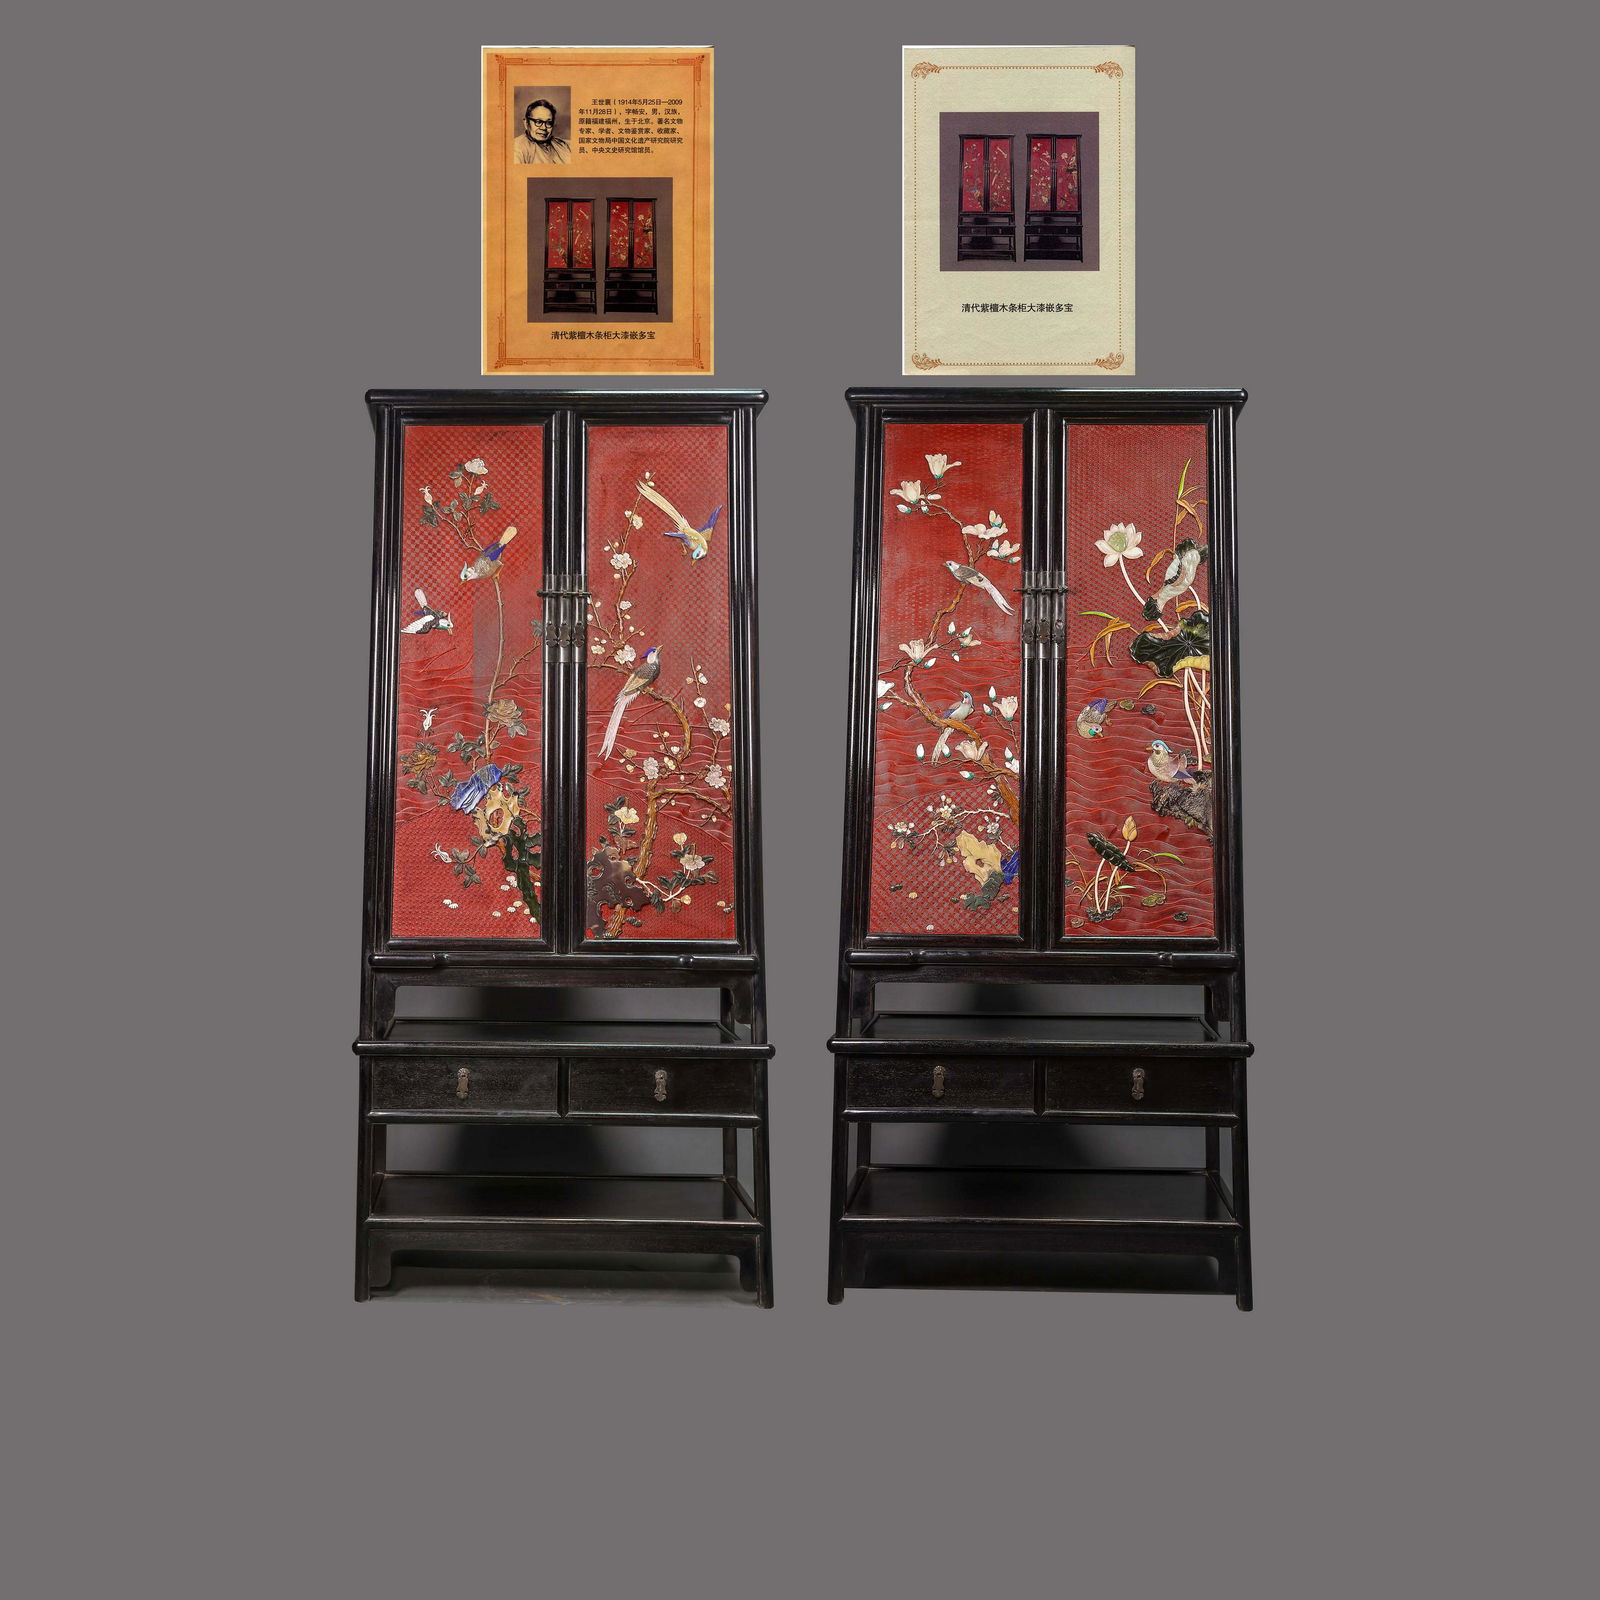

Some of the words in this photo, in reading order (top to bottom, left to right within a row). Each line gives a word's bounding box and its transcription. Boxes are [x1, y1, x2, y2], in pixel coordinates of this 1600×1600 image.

[961, 303, 1074, 313] 清代紫檀木条柜大漆嵌多宝
[551, 330, 656, 340] 清代紫檀木条柜大漆嵌多宝
